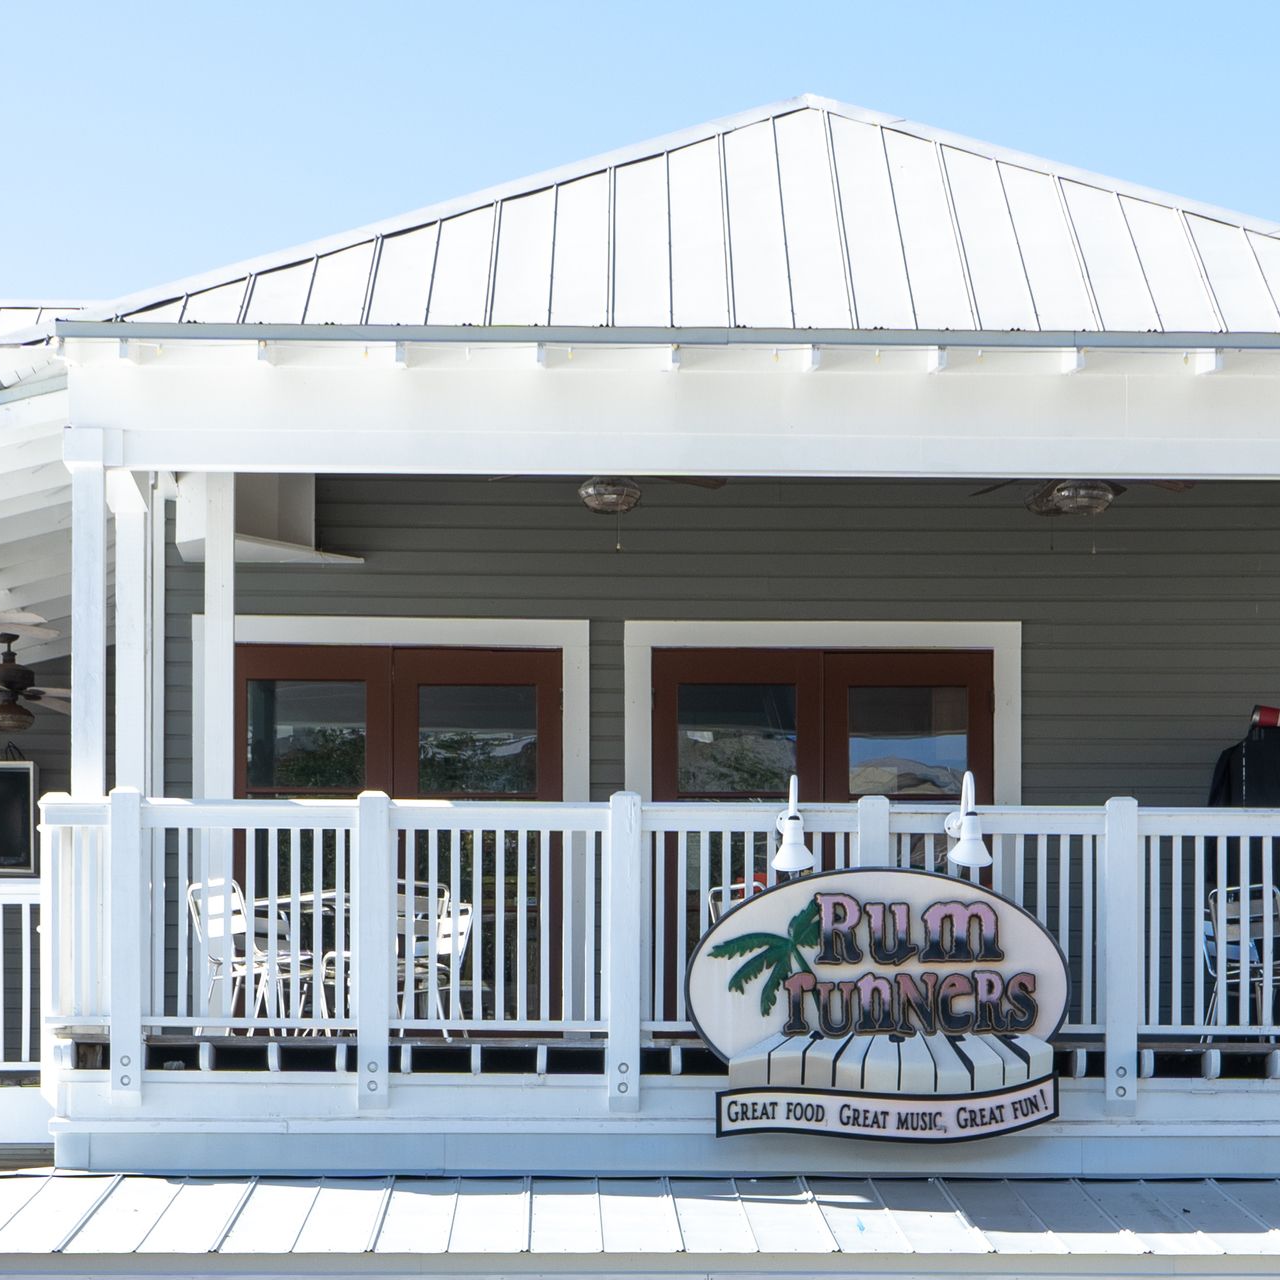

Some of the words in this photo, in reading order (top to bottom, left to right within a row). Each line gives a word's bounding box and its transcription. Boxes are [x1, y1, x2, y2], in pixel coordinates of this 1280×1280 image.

[814, 892, 1005, 966] Rum
[726, 1100, 778, 1123] GREAT
[839, 1103, 890, 1129] GREAT
[956, 1103, 1005, 1130] GREAT
[1011, 1088, 1049, 1120] FUN!
